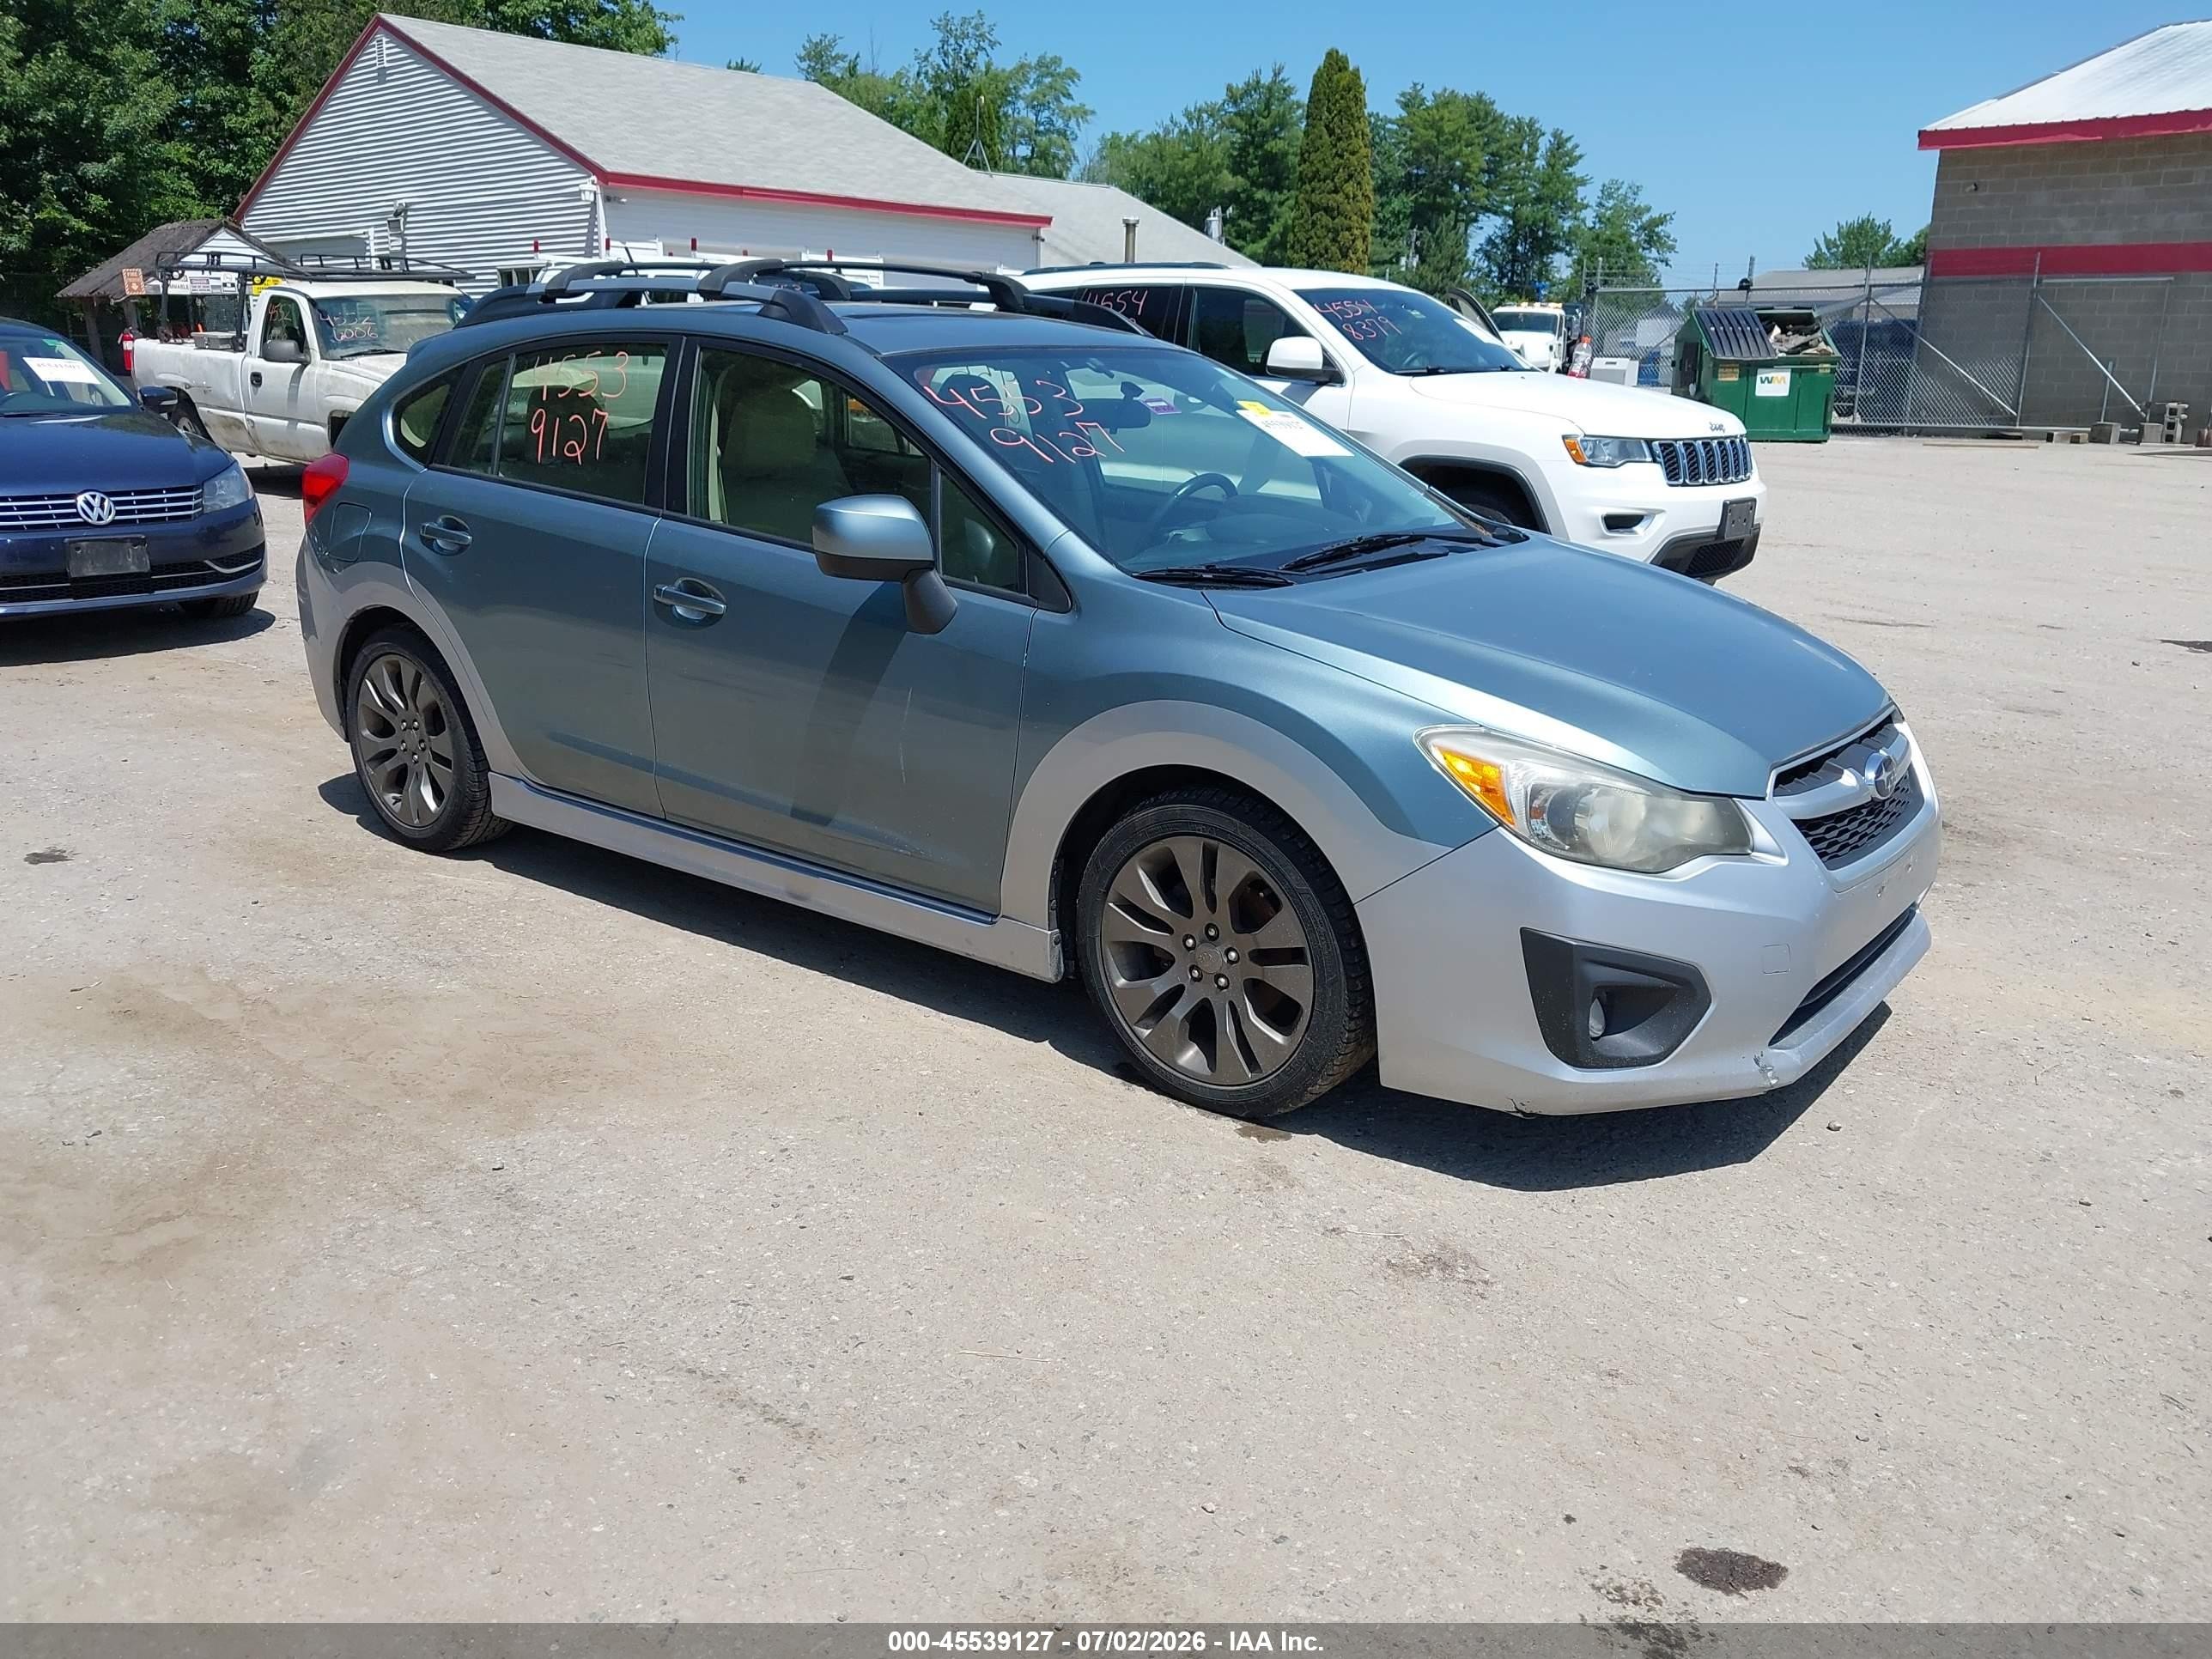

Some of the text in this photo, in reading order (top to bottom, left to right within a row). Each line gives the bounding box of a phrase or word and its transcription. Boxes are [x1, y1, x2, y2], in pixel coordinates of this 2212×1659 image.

[1314, 300, 1378, 321] 4554
[1342, 315, 1402, 341] 8379
[1759, 376, 1786, 385] WM
[923, 380, 1084, 420] 4553
[531, 408, 609, 465] 9127
[990, 422, 1126, 464] 9127
